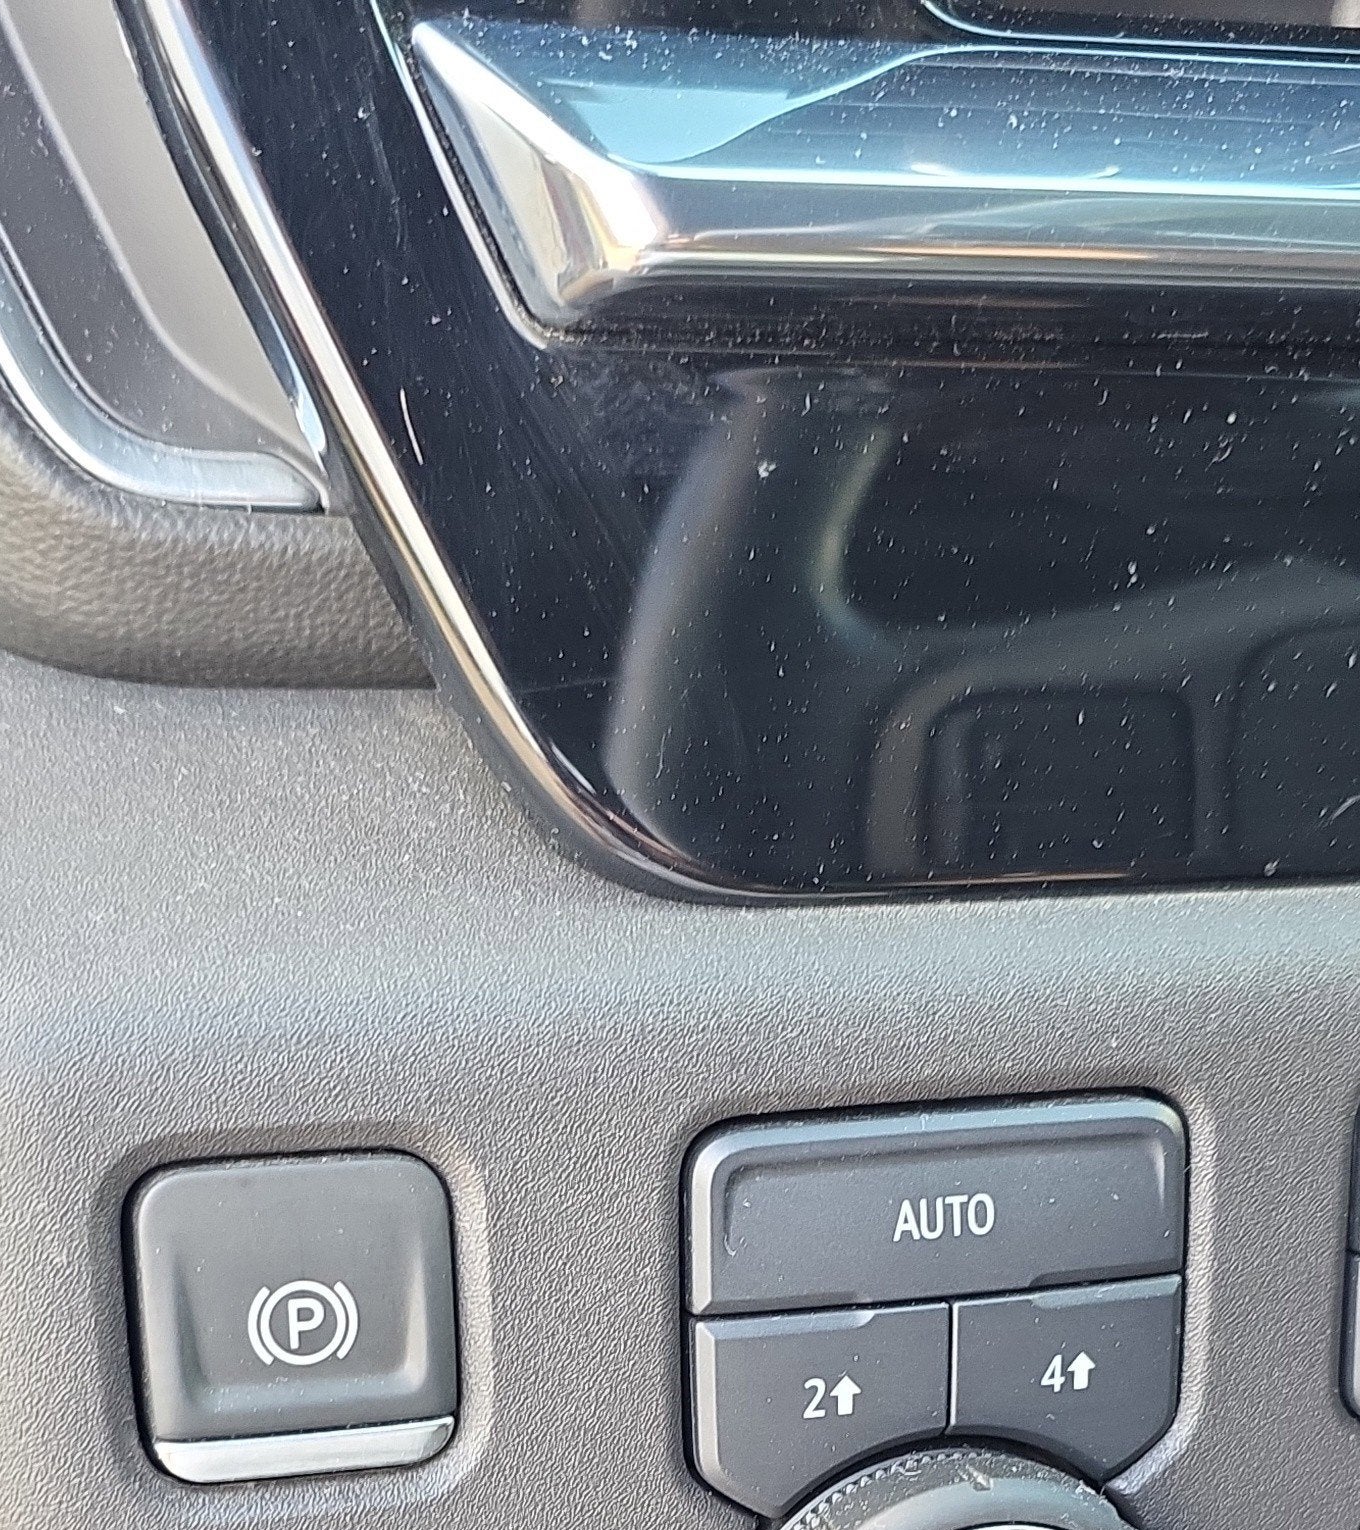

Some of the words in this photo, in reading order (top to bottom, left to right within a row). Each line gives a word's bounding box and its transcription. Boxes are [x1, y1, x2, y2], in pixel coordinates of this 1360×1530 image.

[893, 1193, 995, 1242] AUTO
[1041, 1354, 1065, 1393] 4
[802, 1378, 827, 1419] 2
